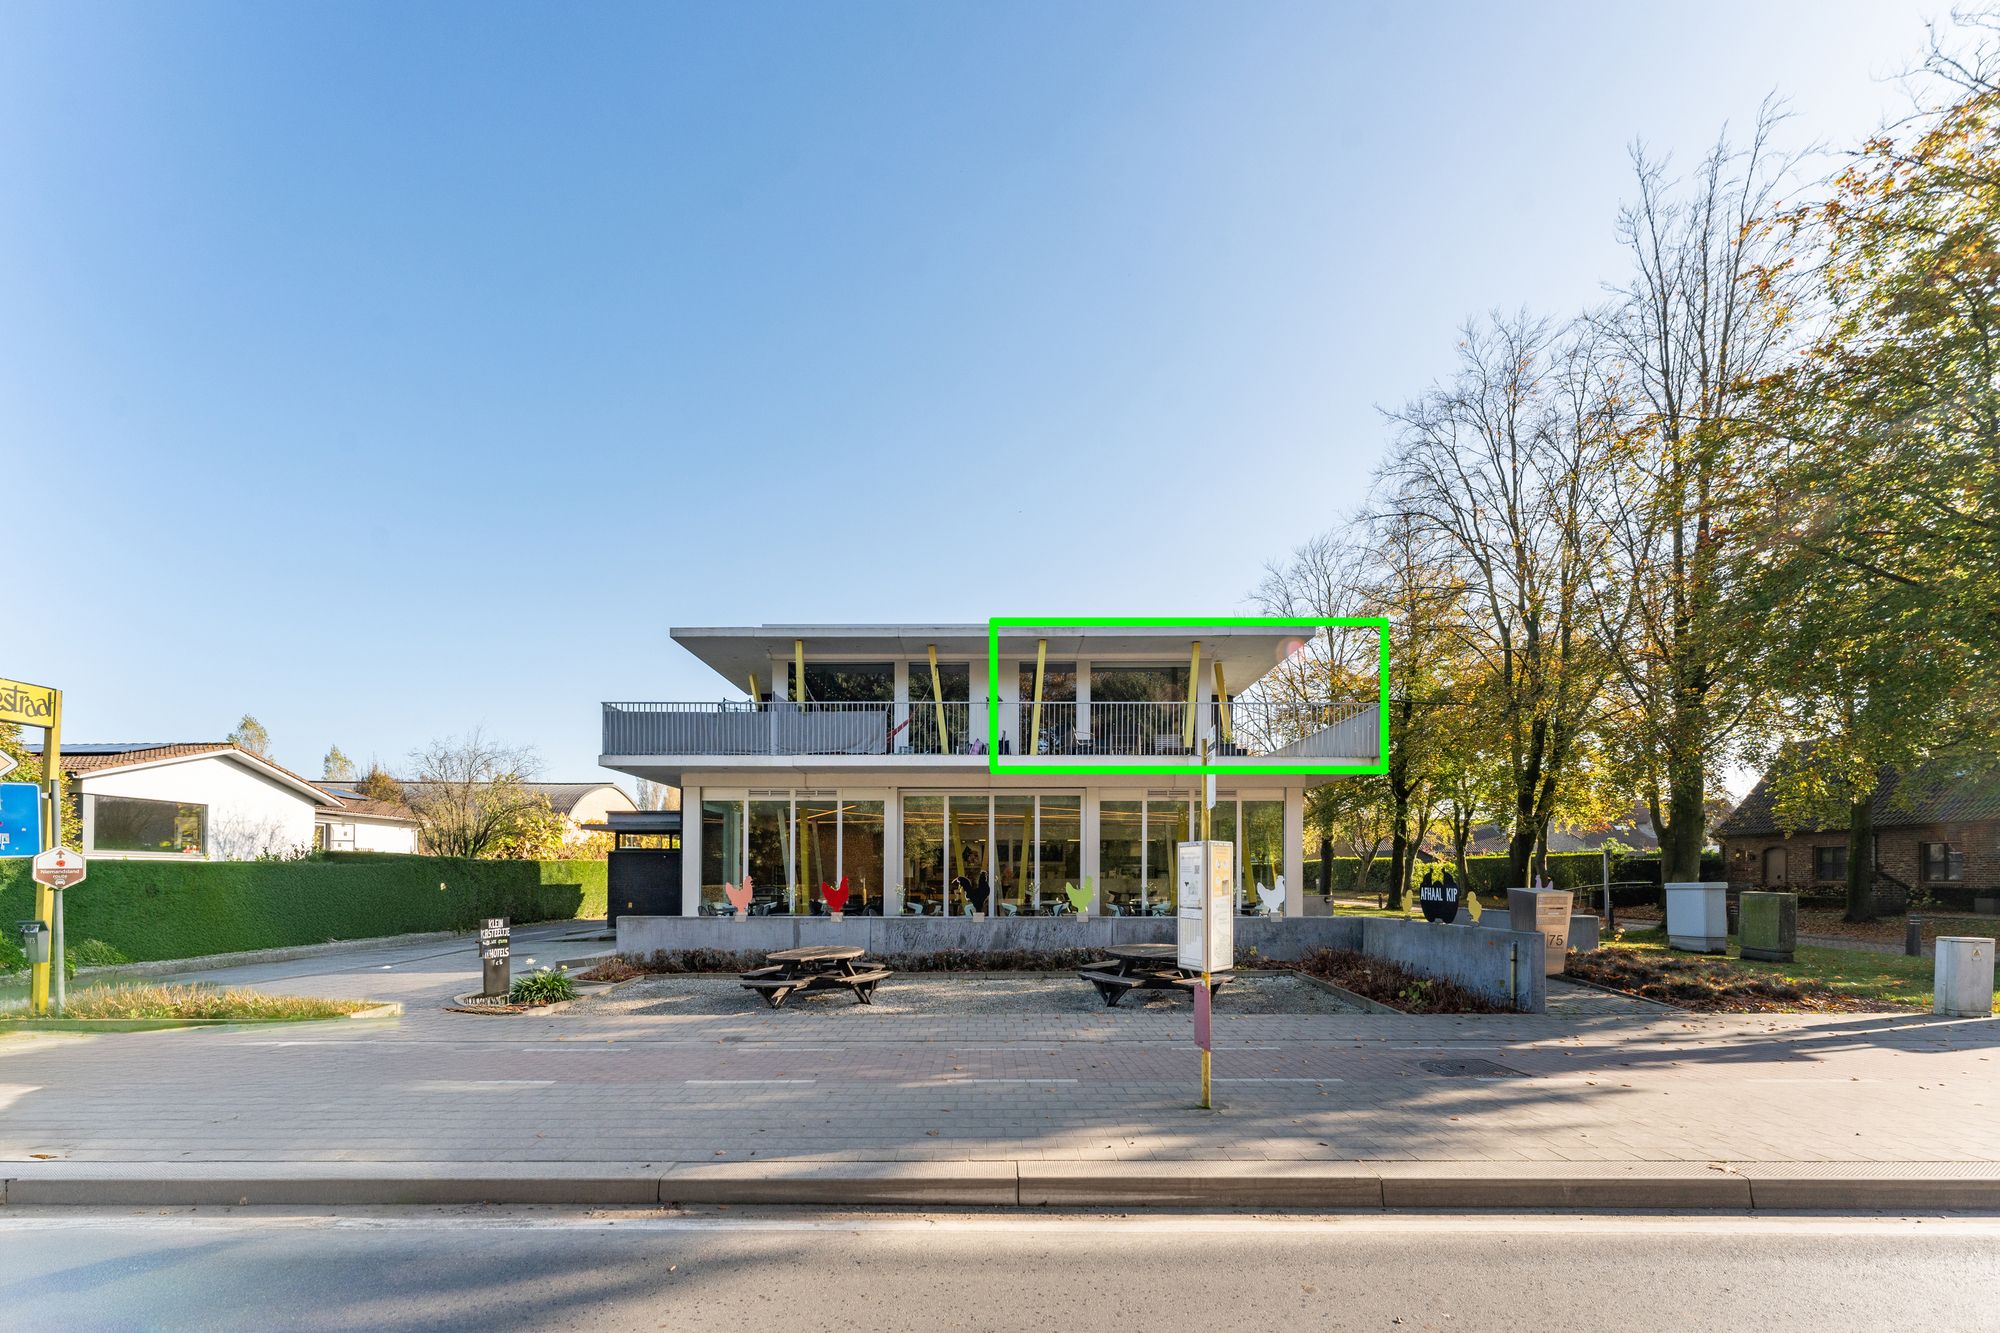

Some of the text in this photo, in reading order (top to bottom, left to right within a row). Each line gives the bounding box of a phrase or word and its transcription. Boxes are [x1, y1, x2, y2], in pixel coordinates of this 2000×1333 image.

[1420, 887, 1458, 902] AFHAAL KIP
[488, 919, 503, 928] KLEIN
[1549, 934, 1564, 946] 75
